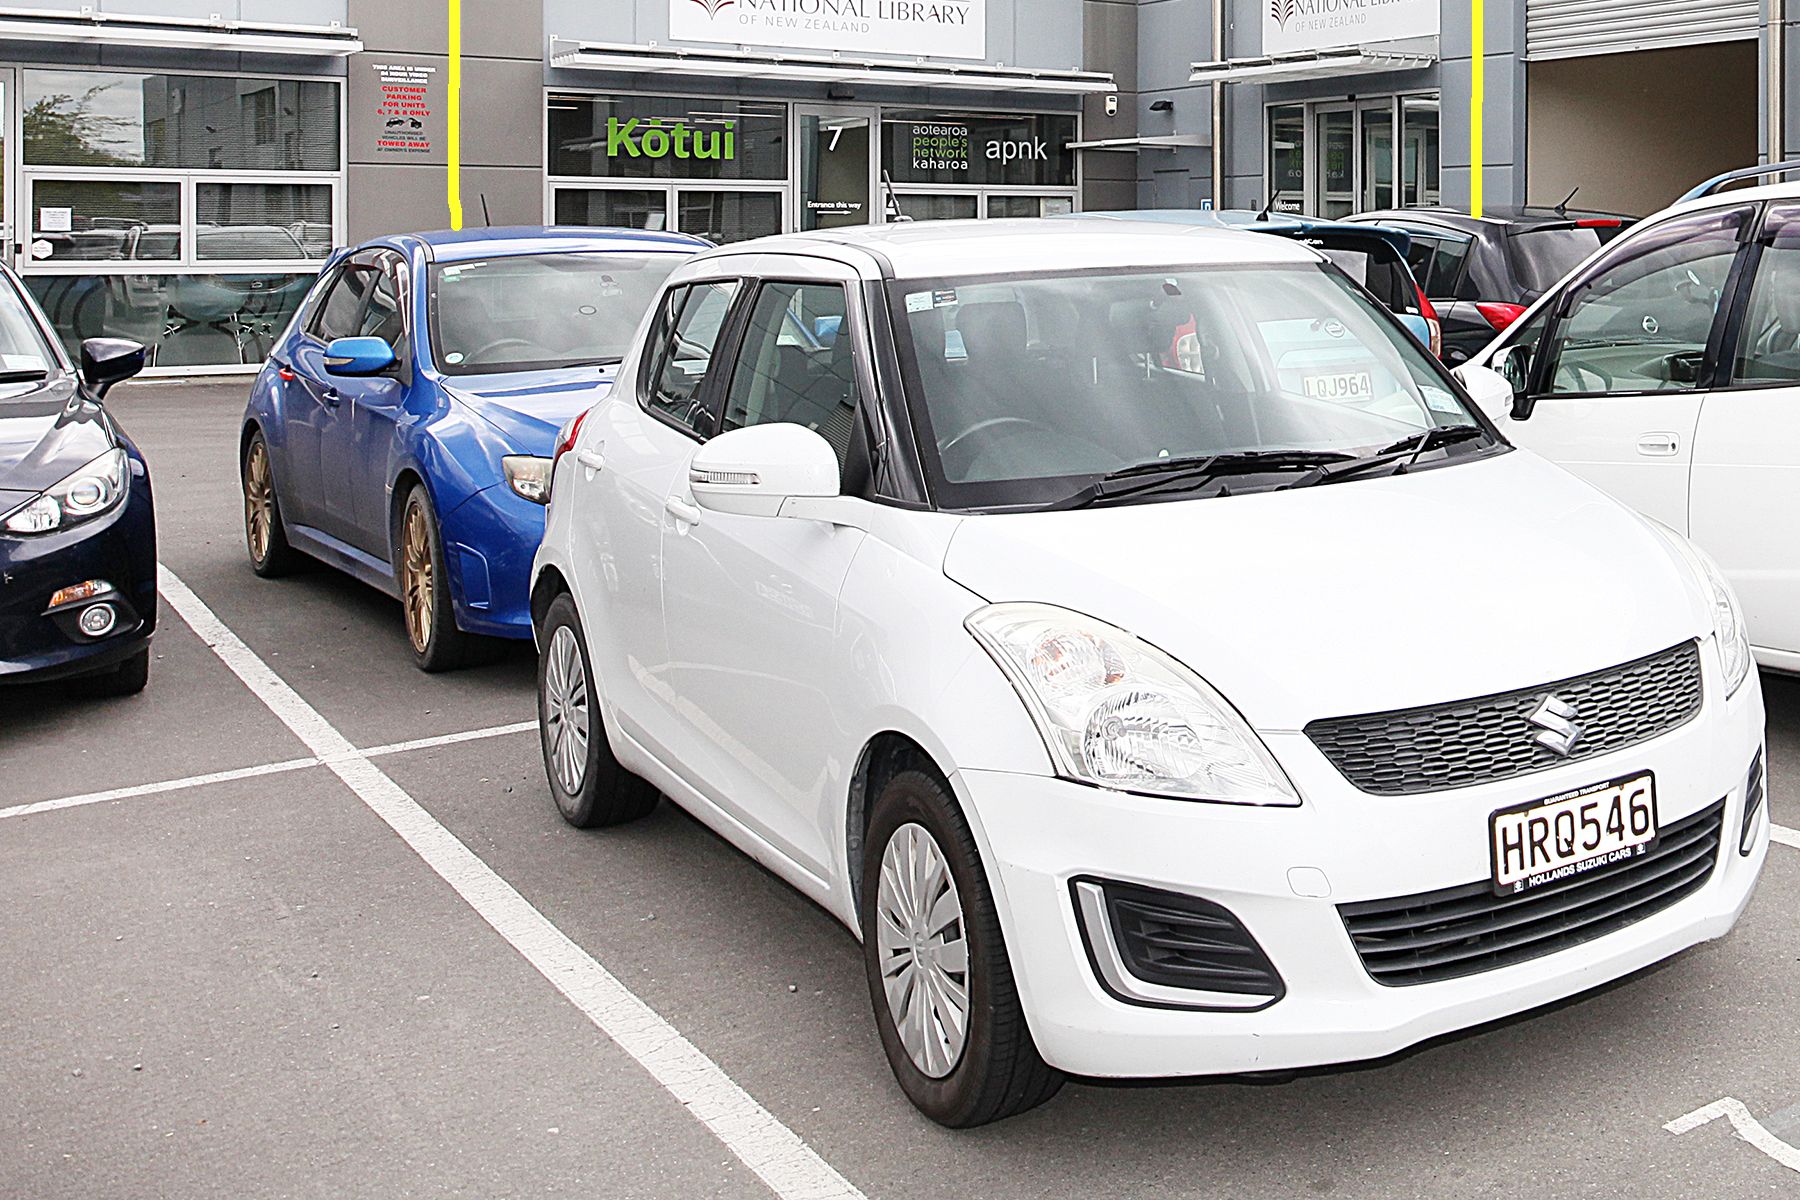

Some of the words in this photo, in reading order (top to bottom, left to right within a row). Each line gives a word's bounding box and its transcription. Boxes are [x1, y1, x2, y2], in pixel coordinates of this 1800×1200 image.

[879, 0, 970, 25] LIBRARY
[739, 14, 758, 26] OF
[765, 15, 798, 29] NEW
[804, 17, 870, 33] ZEALAND
[1295, 22, 1305, 33] OF
[1308, 18, 1327, 31] NEW
[1330, 13, 1367, 28] ZEALAND
[381, 85, 427, 93] CUSTOMER
[827, 125, 844, 152] 7
[912, 125, 968, 136] aotearoa
[912, 136, 968, 149] people's
[985, 136, 1048, 165] apnk
[912, 146, 968, 159] network
[912, 157, 968, 170] kaharoa
[807, 200, 835, 208] Entrance
[1275, 201, 1300, 211] Welcome
[1543, 790, 1579, 805] GUARANTEED
[1580, 781, 1610, 795] TRANSPORT
[1502, 788, 1650, 875] HRQ546
[1528, 864, 1575, 887] HOLLANDS
[1576, 856, 1608, 873] SUZUKI
[1608, 847, 1632, 862] CARS
